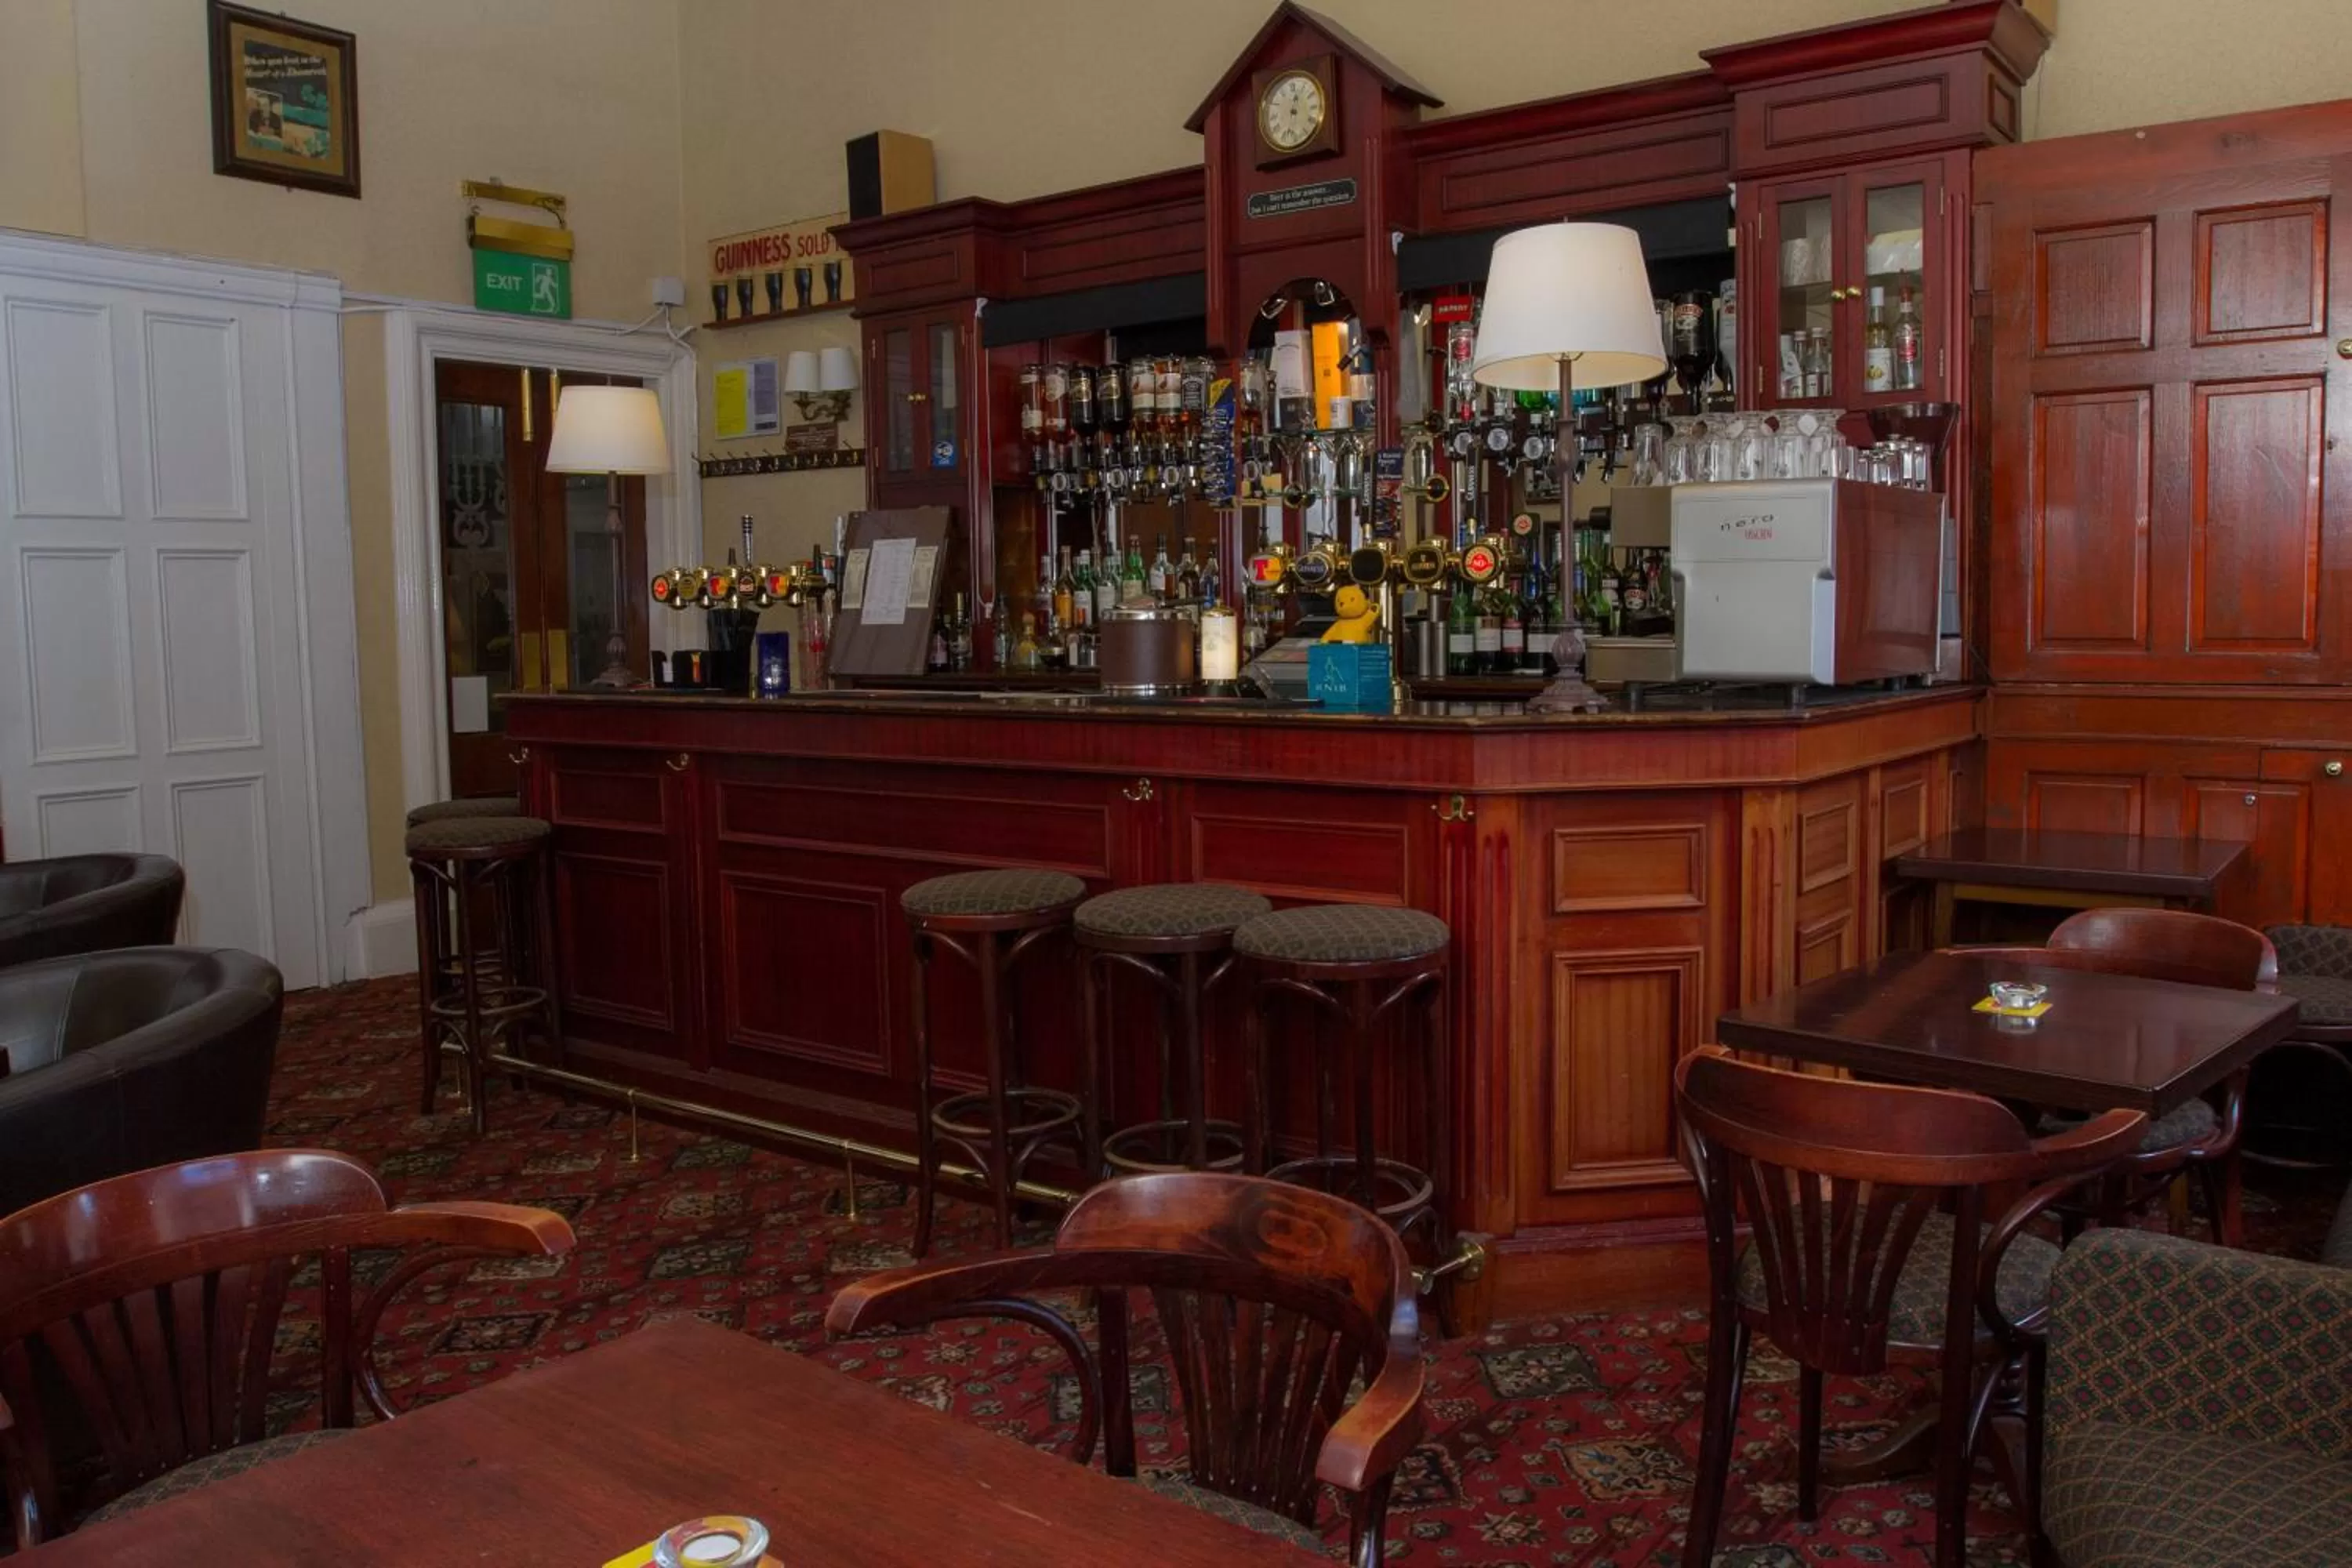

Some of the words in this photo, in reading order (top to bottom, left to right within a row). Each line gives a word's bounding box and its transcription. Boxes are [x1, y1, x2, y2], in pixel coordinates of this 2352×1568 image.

[715, 232, 791, 273] GUINNESS
[797, 232, 829, 258] SOLD
[486, 272, 524, 292] EXIT
